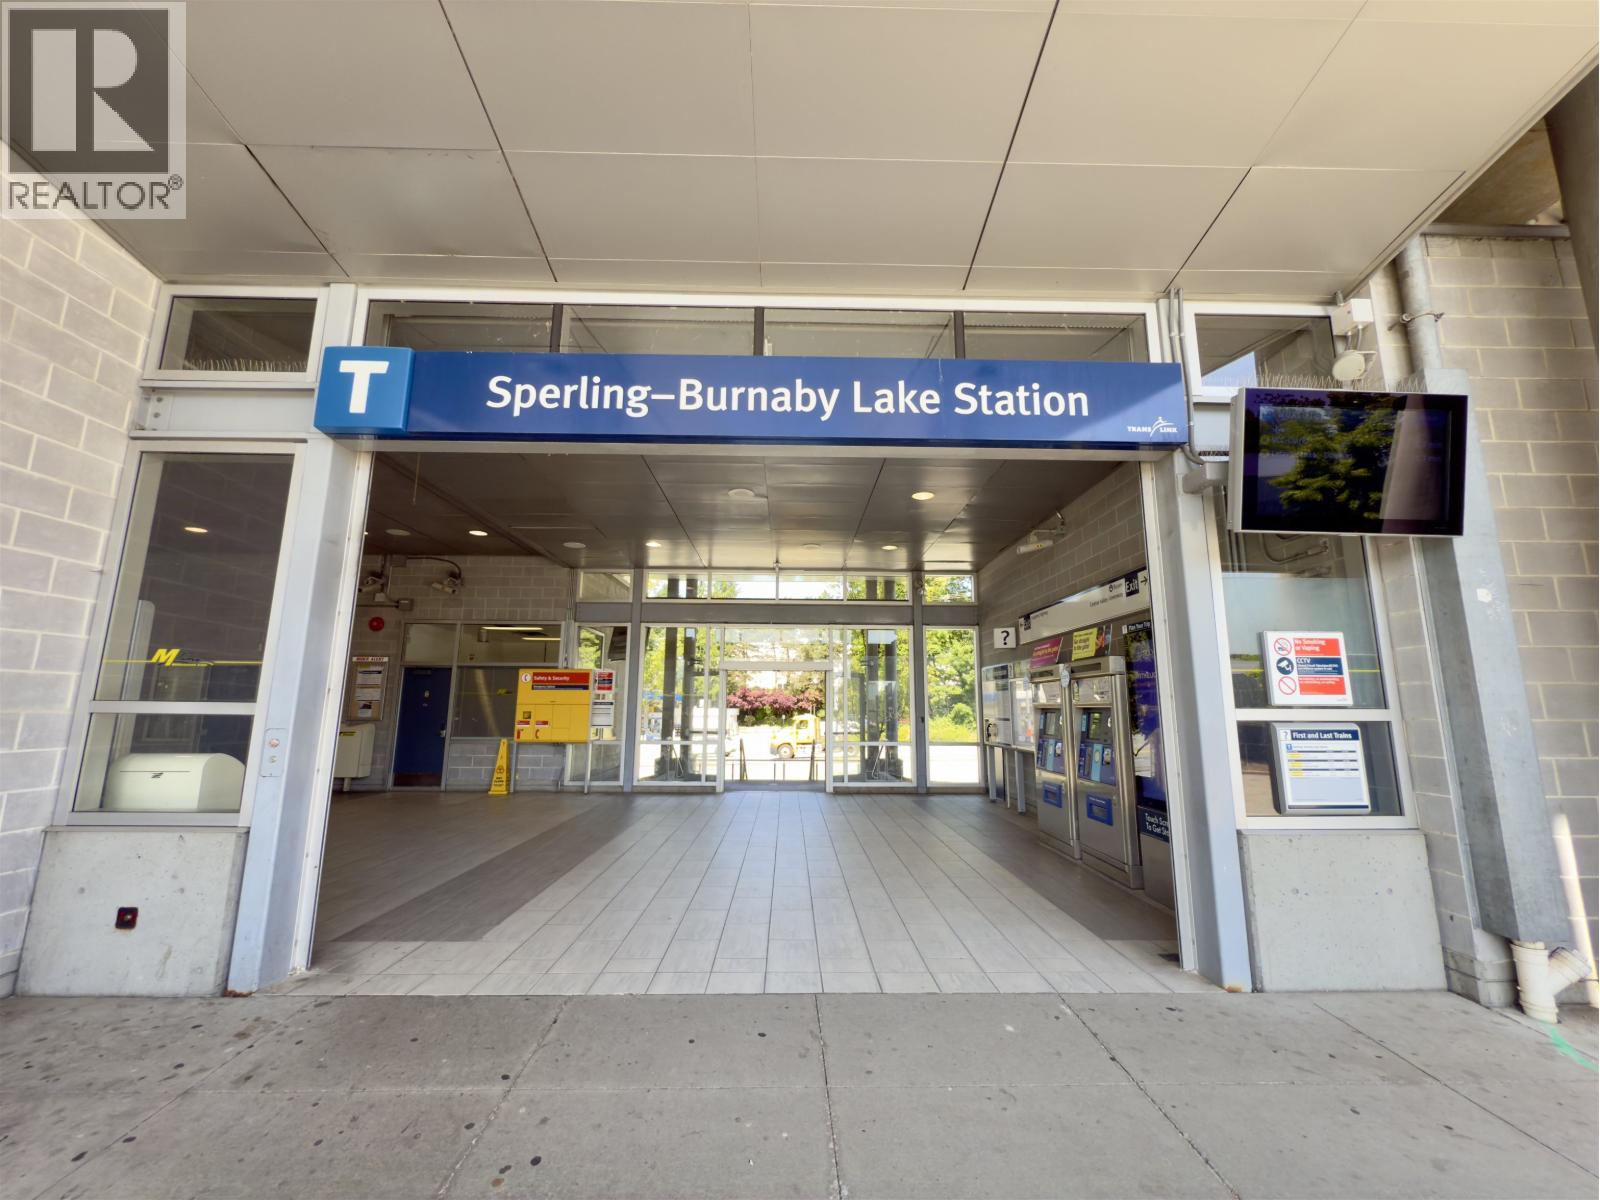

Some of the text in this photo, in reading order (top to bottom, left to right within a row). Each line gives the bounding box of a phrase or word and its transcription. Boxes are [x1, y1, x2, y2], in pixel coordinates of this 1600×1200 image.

[339, 360, 390, 414] T
[853, 380, 941, 415] Lake
[953, 382, 1089, 417] Station
[1125, 579, 1139, 593] Exit
[1145, 813, 1159, 824] Touch
[1146, 822, 1152, 831] To
[1152, 824, 1161, 833] Get
